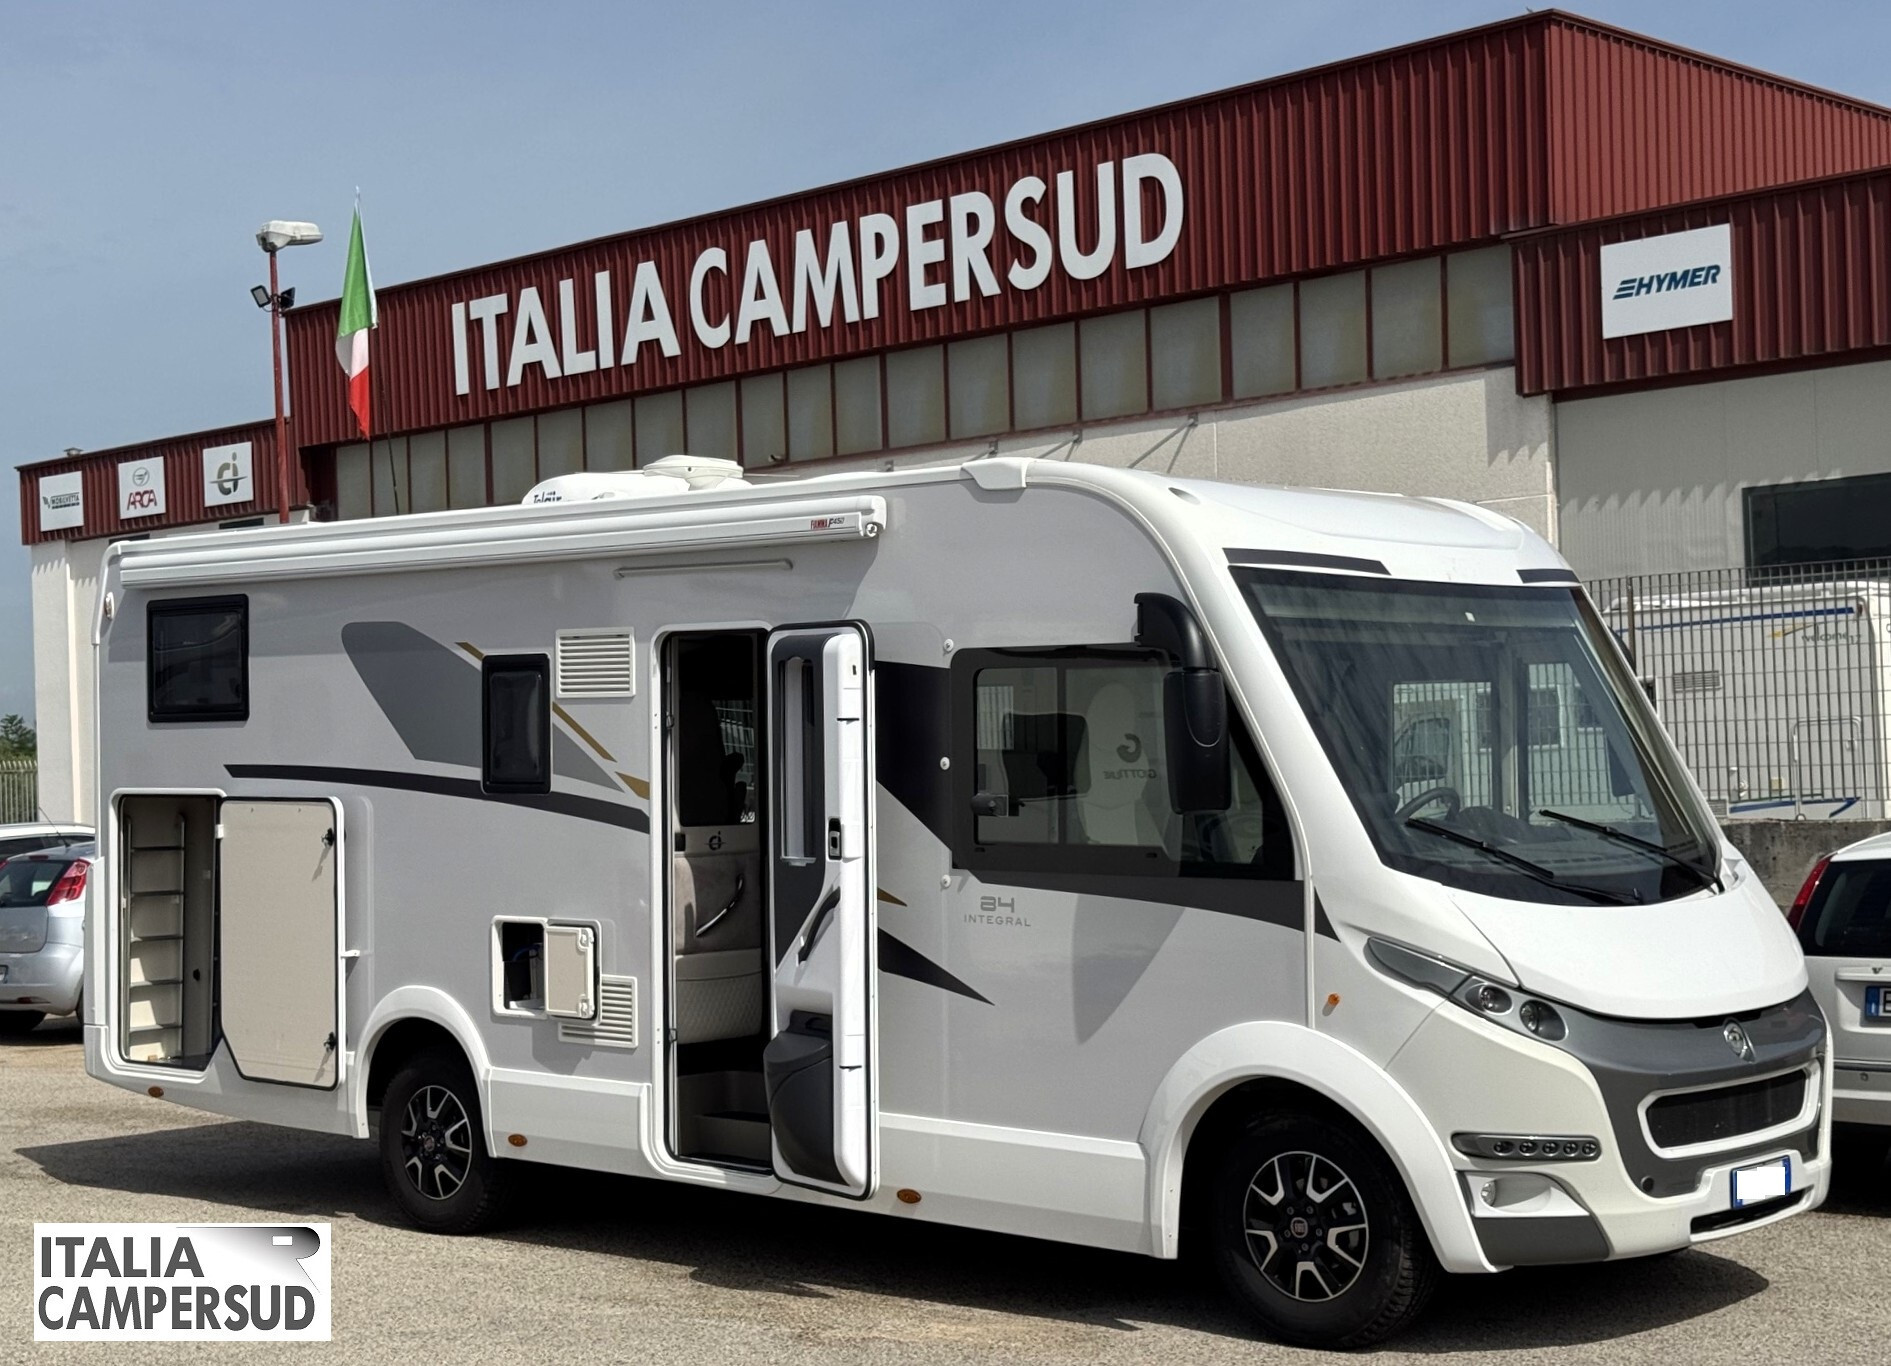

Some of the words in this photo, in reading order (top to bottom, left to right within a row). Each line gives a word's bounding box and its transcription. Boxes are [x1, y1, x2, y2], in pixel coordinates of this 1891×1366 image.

[451, 260, 682, 397] ITALIA
[688, 151, 1185, 350] CAMPERSUD
[1634, 264, 1721, 297] HYMER
[126, 489, 158, 511] ARCA
[963, 914, 1031, 927] INTEGRAL
